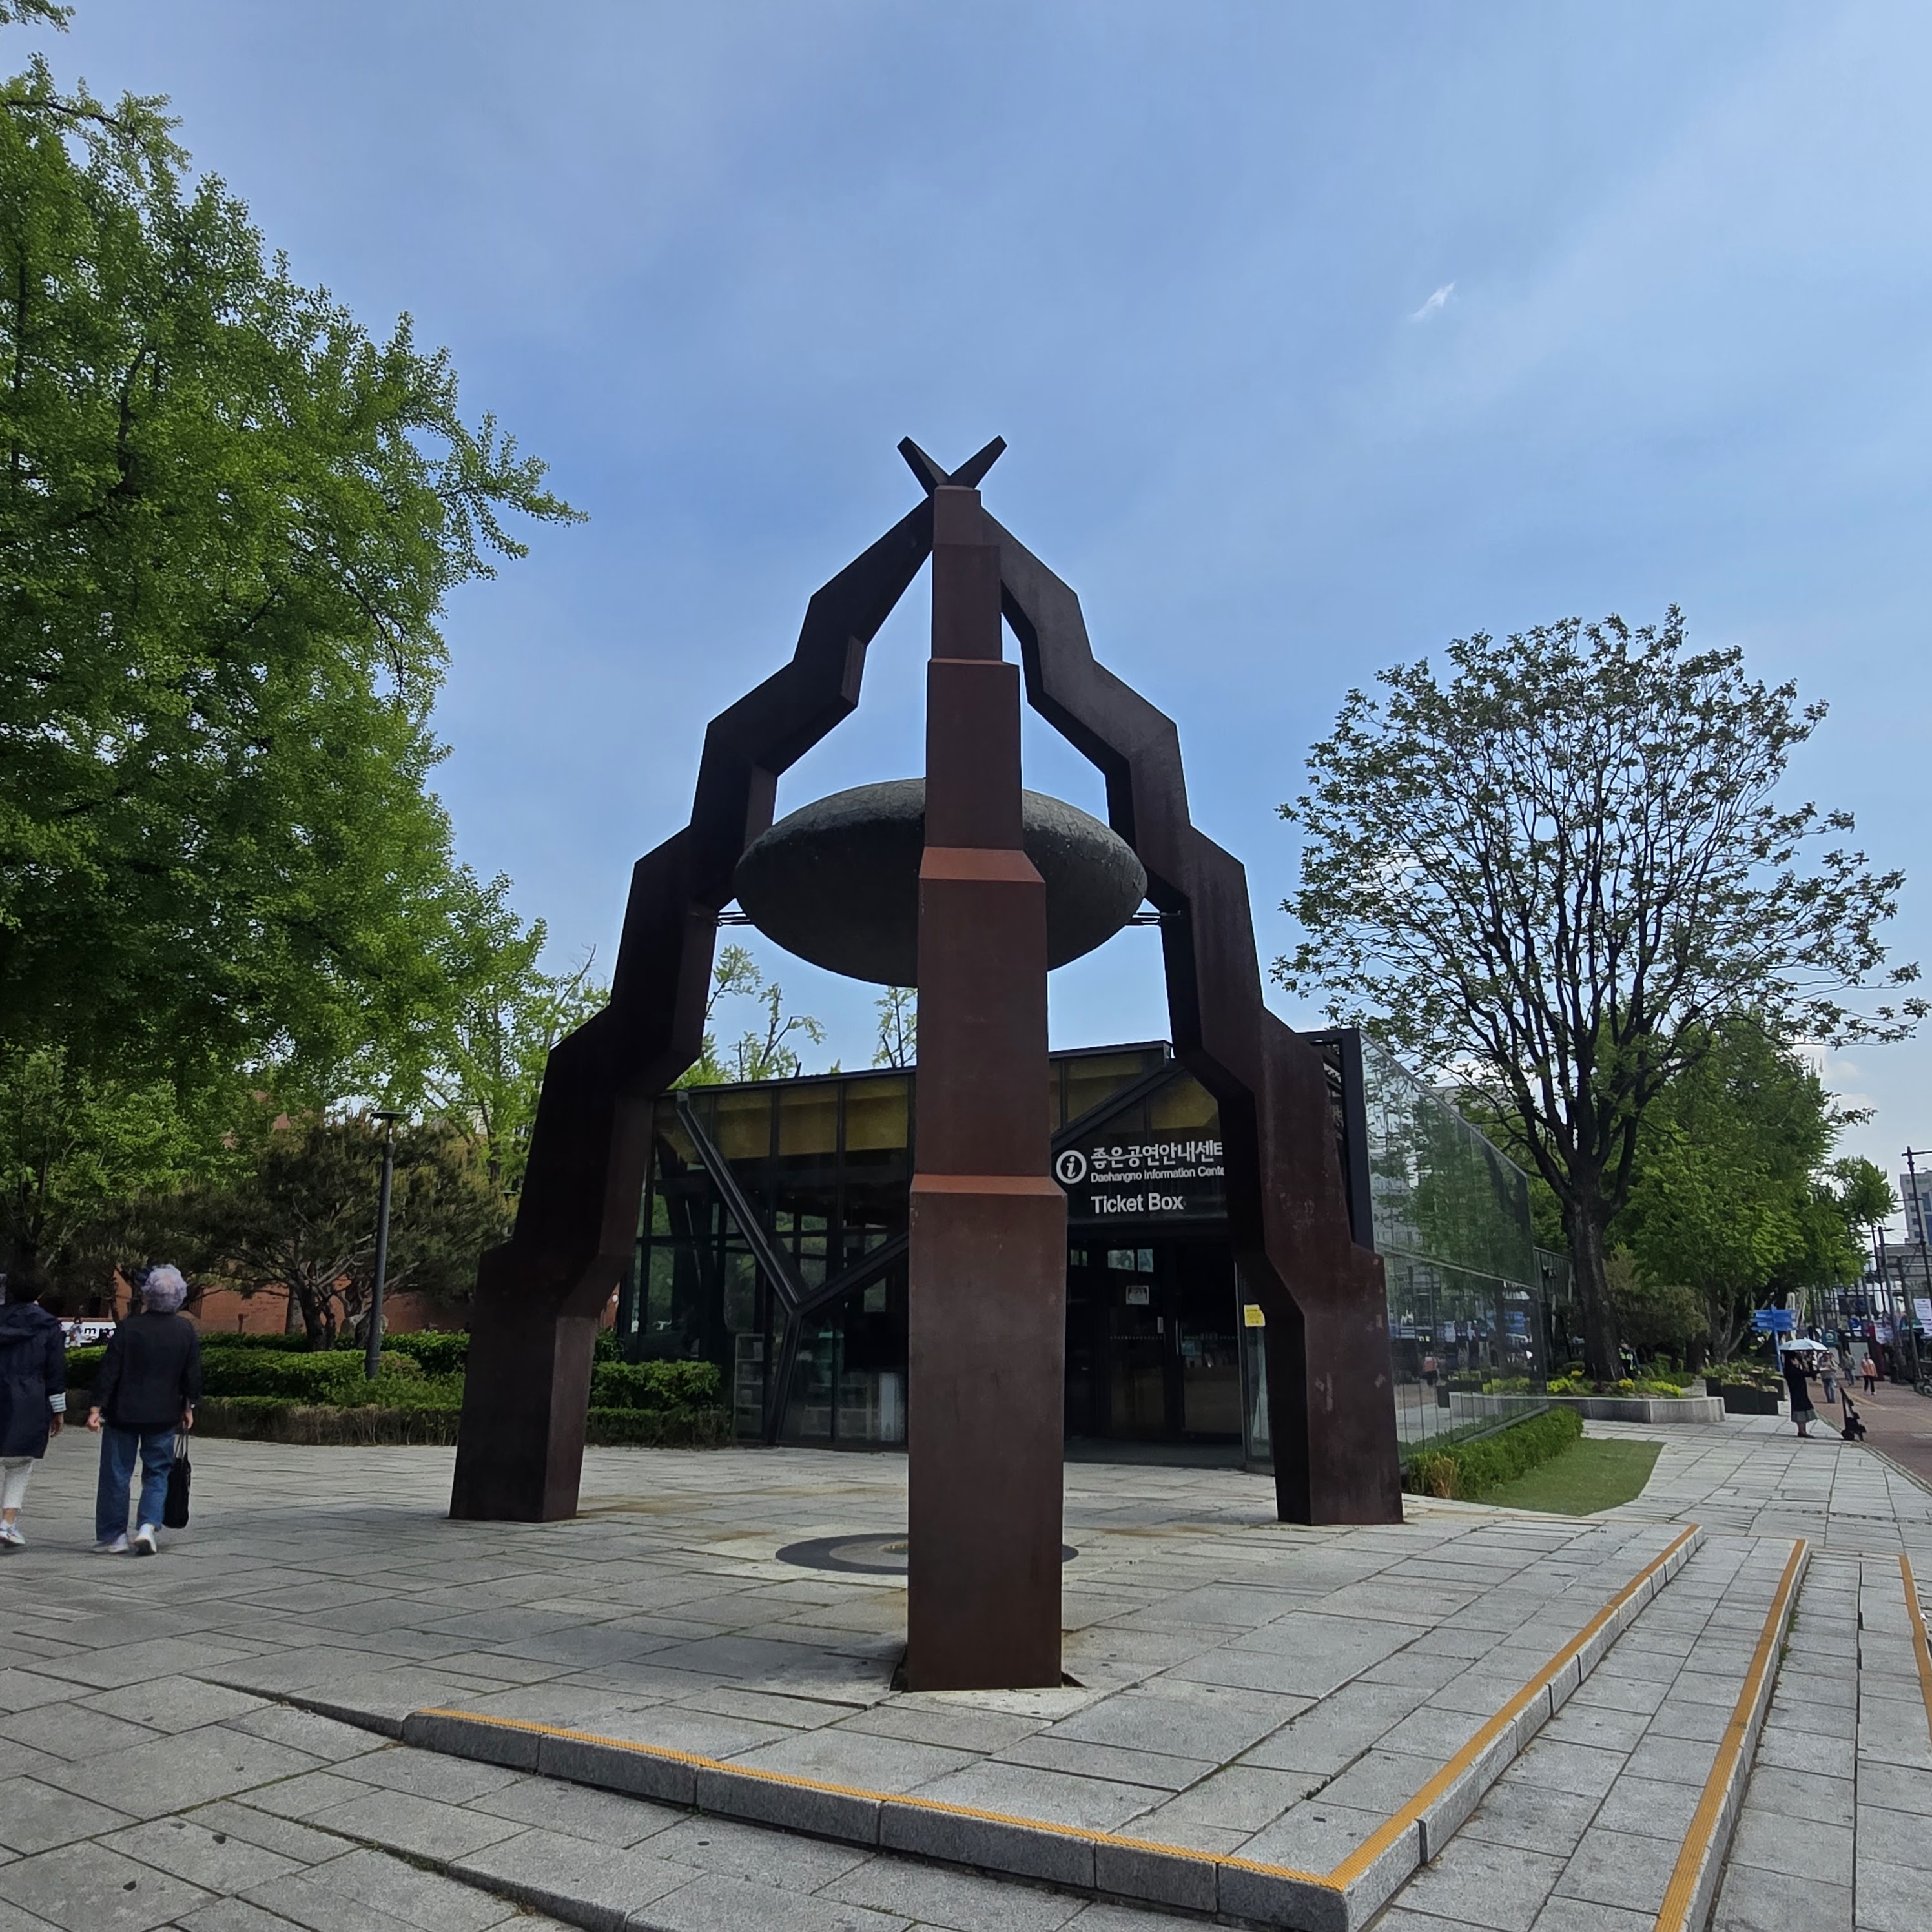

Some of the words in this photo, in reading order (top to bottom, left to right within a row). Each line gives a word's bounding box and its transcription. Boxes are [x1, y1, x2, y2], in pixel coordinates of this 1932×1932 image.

[1091, 1171, 1142, 1183] Daehangno
[1144, 1167, 1195, 1180] Information
[1198, 1166, 1224, 1177] Cente
[1091, 1194, 1144, 1213] Ticket
[1148, 1192, 1184, 1211] Box
